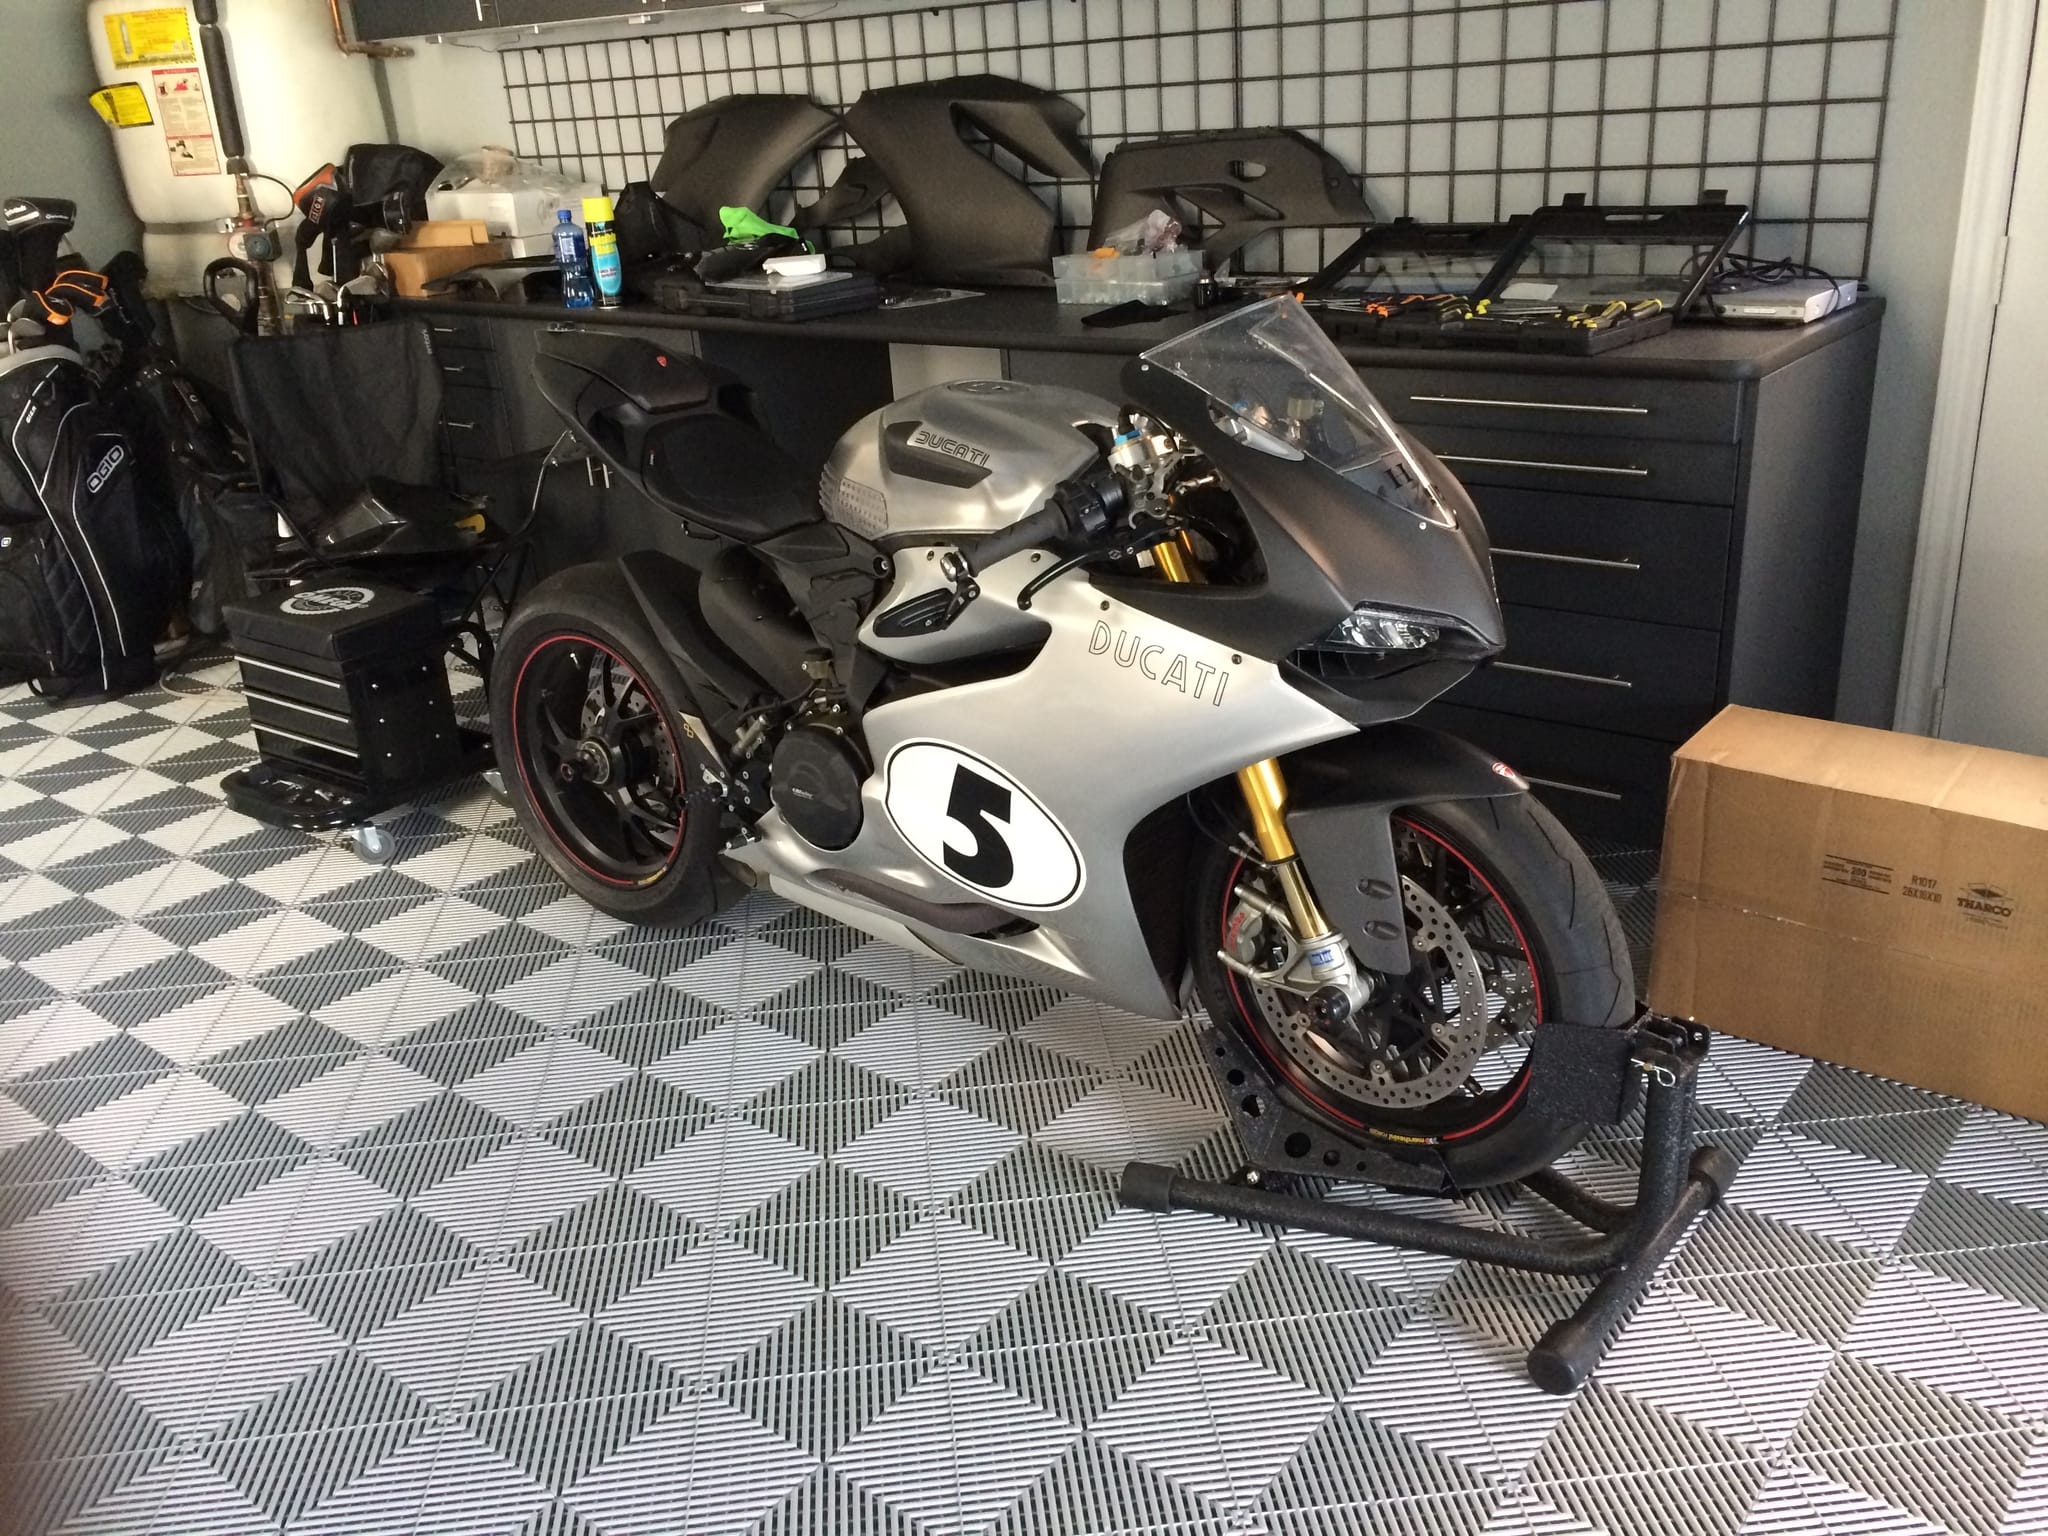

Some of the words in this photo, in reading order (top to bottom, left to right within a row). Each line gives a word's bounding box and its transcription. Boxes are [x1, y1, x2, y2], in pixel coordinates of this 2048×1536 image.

[86, 444, 124, 493] OGIO
[914, 430, 990, 467] DUCATI
[1088, 620, 1230, 707] DUCATI
[943, 763, 1014, 889] 5
[1957, 897, 2012, 917] THARCO
